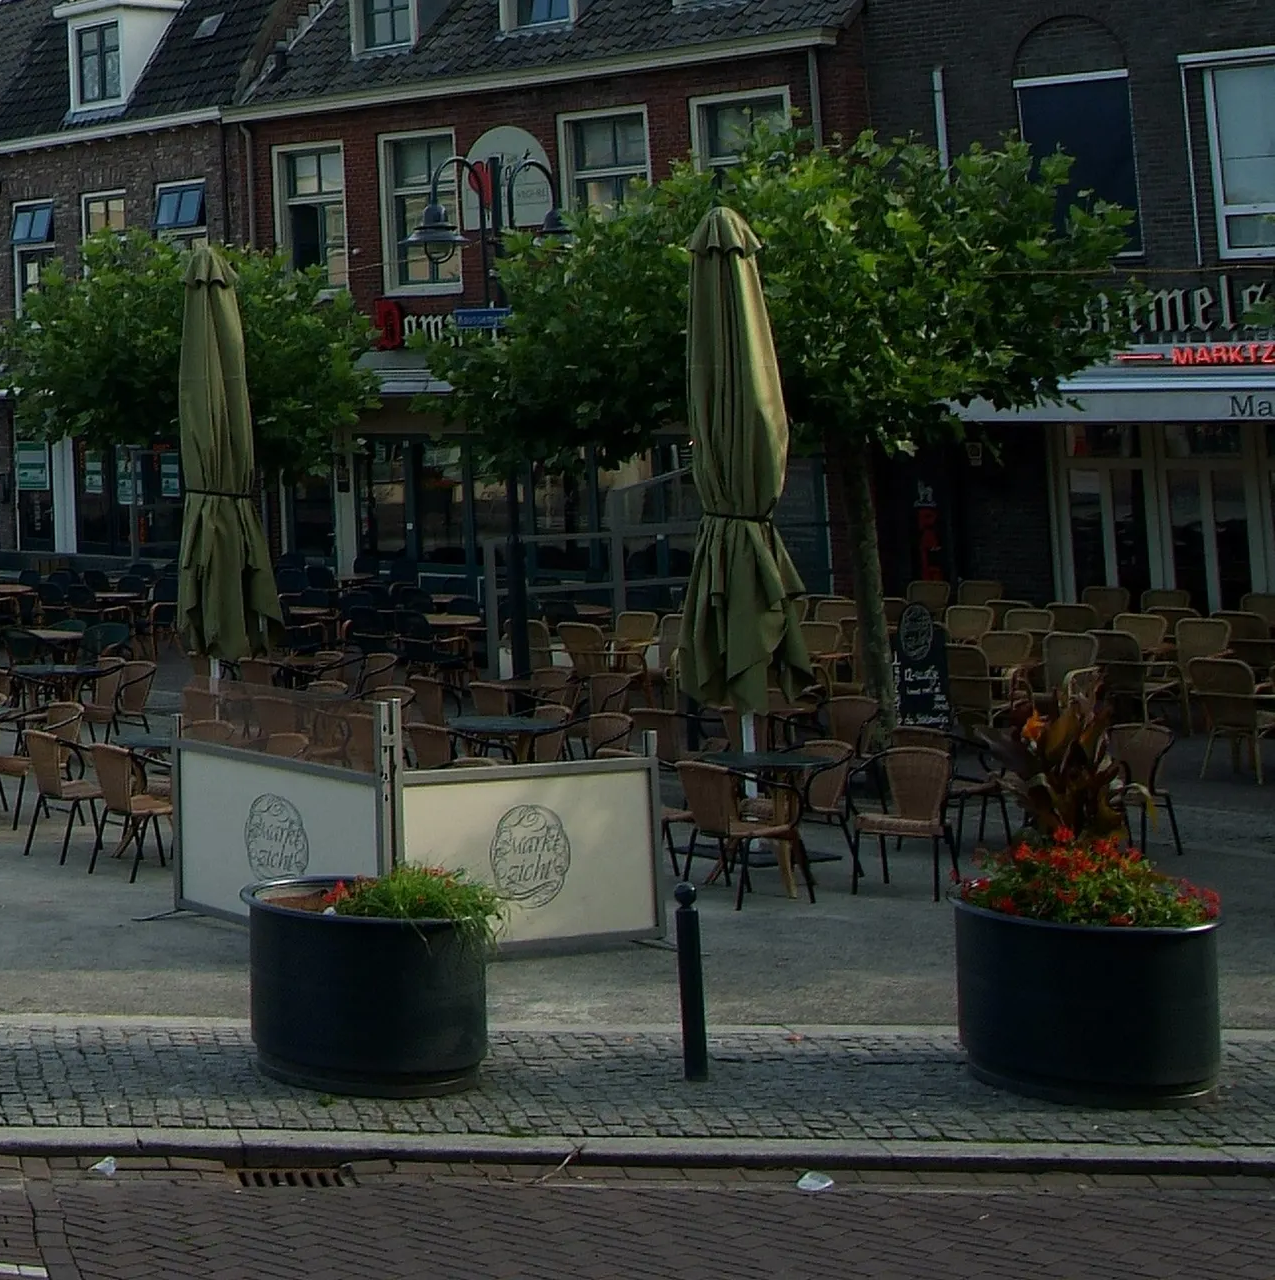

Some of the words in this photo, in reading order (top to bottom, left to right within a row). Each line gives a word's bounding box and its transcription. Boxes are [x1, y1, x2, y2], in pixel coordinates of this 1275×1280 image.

[1171, 344, 1275, 365] MARKTZ
[1229, 395, 1273, 418] Ma
[499, 825, 560, 854] Markt
[508, 853, 552, 882] zicht
